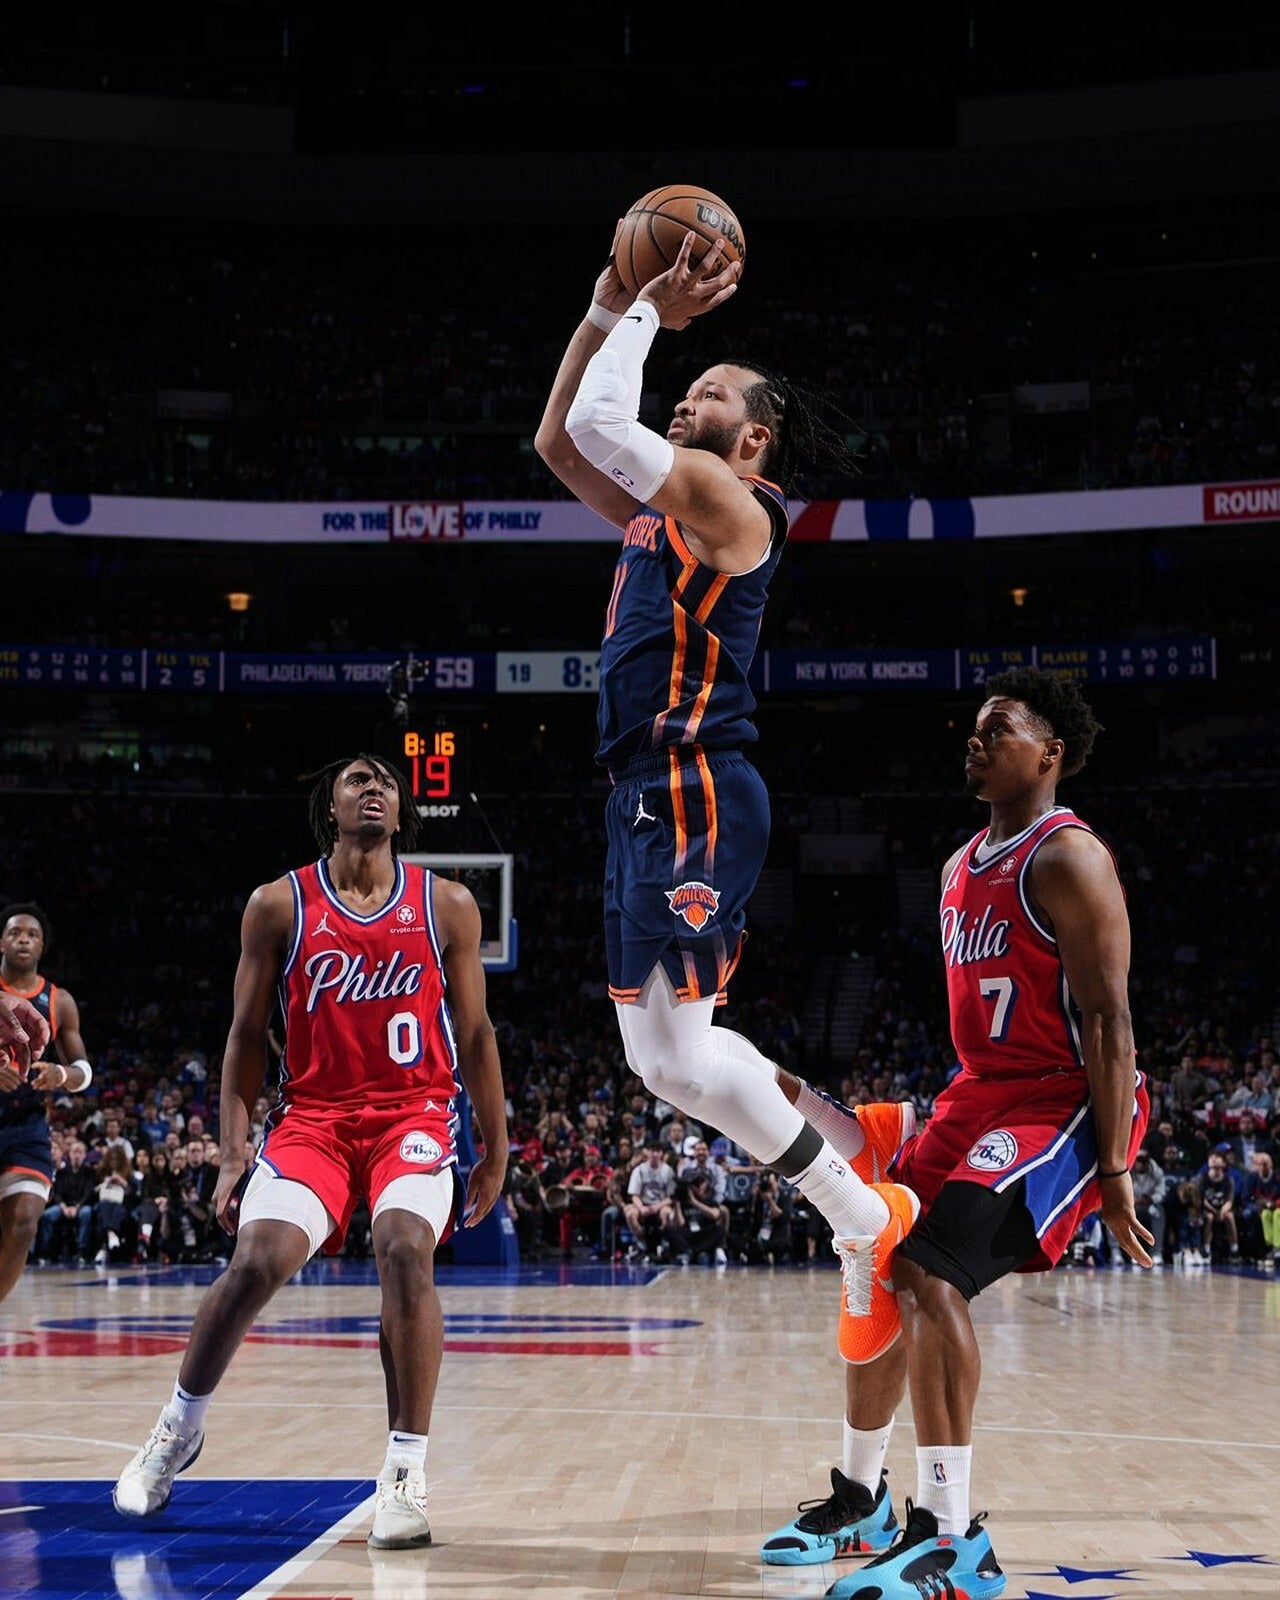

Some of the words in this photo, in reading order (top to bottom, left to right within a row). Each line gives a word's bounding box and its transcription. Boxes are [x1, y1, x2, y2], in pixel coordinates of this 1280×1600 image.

[696, 203, 745, 264] Wilso
[1213, 488, 1280, 516] ROUN
[322, 513, 355, 531] FOR
[359, 513, 390, 530] THE
[391, 504, 461, 539] LOVE
[463, 512, 485, 529] OF
[489, 512, 541, 530] PHILLY
[29, 651, 40, 664] 9
[51, 652, 66, 665] 12
[73, 653, 89, 666] 21
[100, 654, 109, 667] 7
[122, 654, 134, 668] 0
[1041, 650, 1088, 664] PLAYER
[1167, 645, 1178, 660] 0
[1191, 644, 1204, 660] 11
[159, 667, 173, 686] 2
[193, 668, 207, 687] 5
[241, 664, 336, 682] PHILADELPHIA
[435, 656, 474, 689] 59
[508, 664, 531, 682] 19
[563, 657, 600, 687] 8:
[796, 662, 827, 680] NEW
[831, 661, 867, 679] YORK
[872, 661, 929, 679] KNICKS
[973, 666, 986, 685] 2
[1167, 661, 1179, 676] 0
[404, 732, 455, 757] 8:16
[413, 756, 450, 798] 19
[672, 888, 717, 908] KNICKS
[390, 927, 426, 935] crypto.com
[941, 905, 1010, 967] Phila
[305, 949, 422, 1013] Phila
[979, 976, 1014, 1040] 7
[387, 1011, 420, 1066] 0
